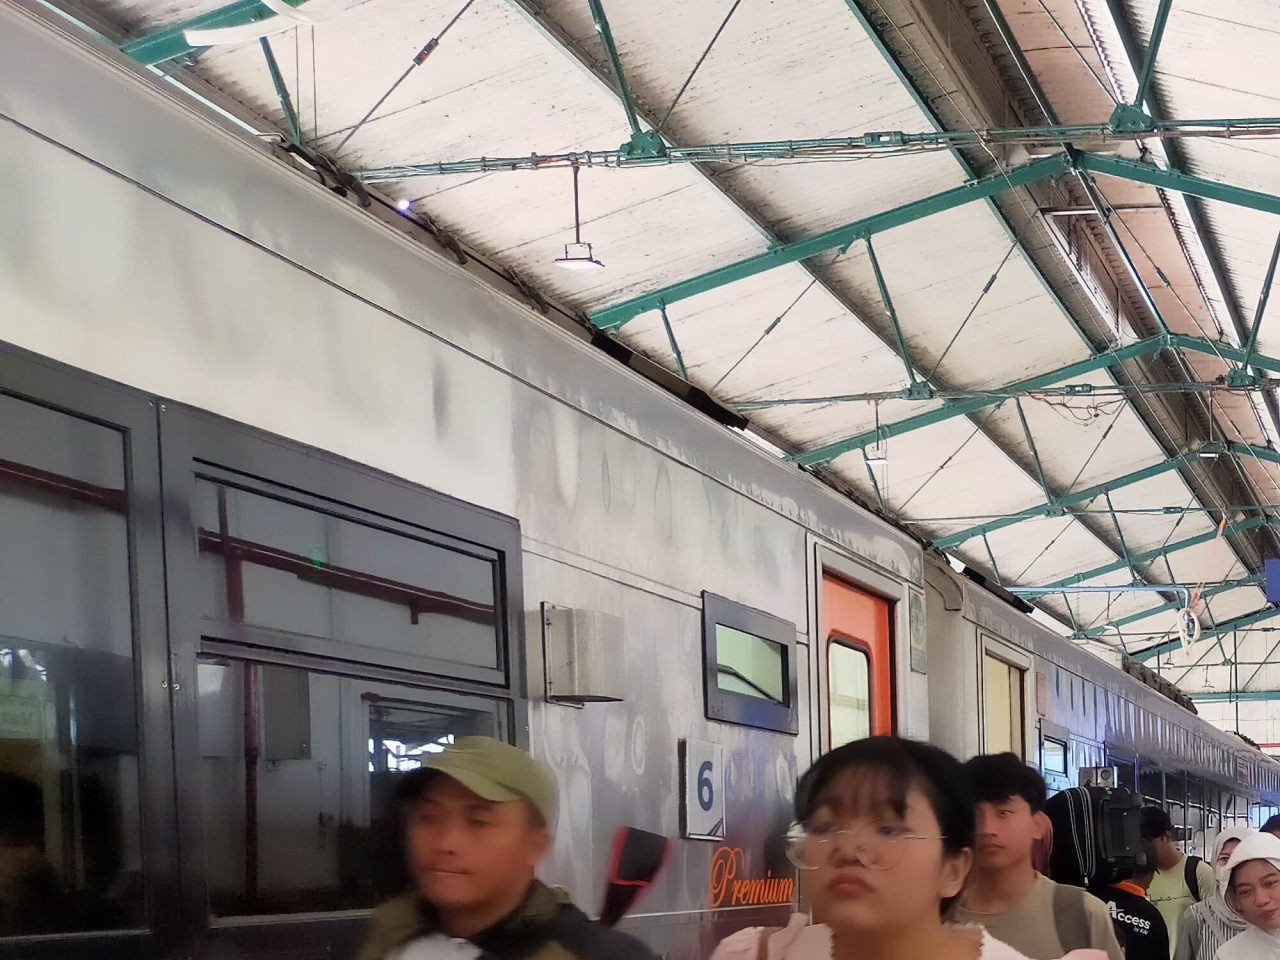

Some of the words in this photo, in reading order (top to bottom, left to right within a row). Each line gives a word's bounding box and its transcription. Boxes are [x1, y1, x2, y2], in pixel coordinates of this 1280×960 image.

[697, 760, 714, 812] 6
[707, 846, 796, 908] Premium
[1106, 900, 1151, 930] Access
